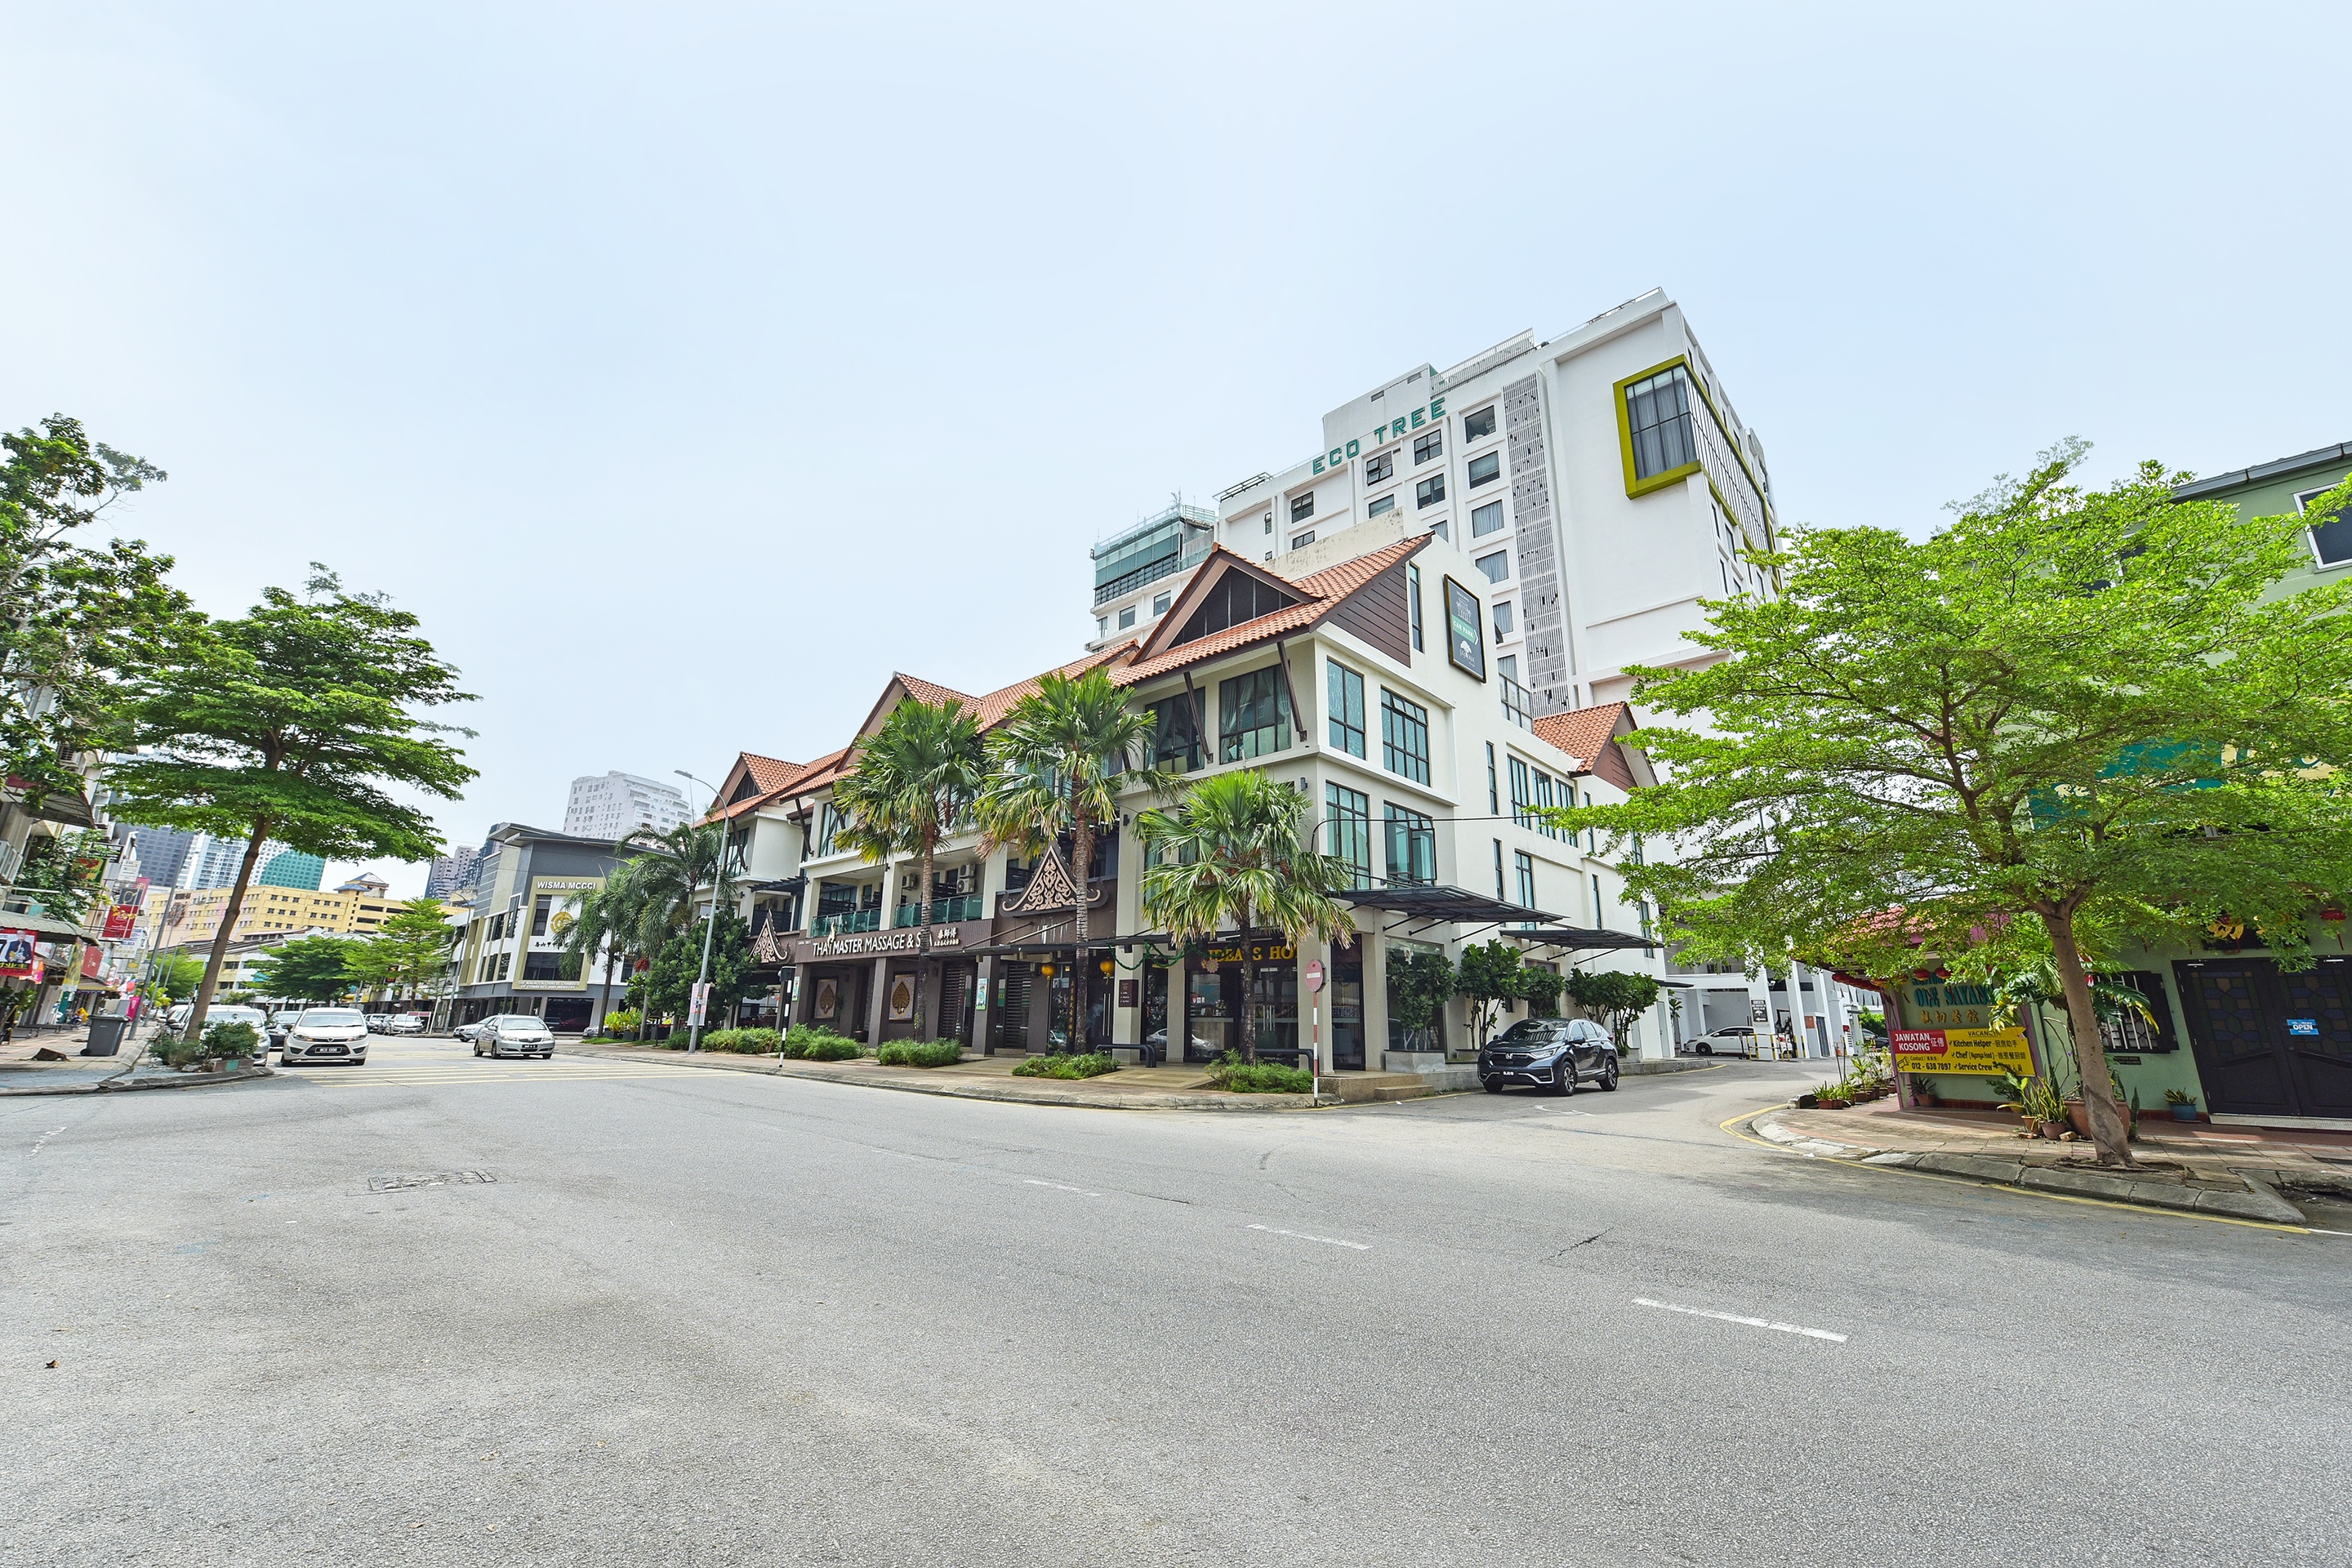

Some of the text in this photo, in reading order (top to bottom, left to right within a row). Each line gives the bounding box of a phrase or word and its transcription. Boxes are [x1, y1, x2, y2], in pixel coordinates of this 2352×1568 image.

[1312, 396, 1446, 475] ECO TREE
[1454, 621, 1474, 638] CAR PARK
[537, 881, 597, 890] WISMA MCCCI
[832, 938, 862, 955] MASTER
[864, 934, 905, 952] MASSAGE
[906, 935, 914, 948] &
[1269, 945, 1297, 960] HO
[1895, 1033, 1931, 1042] JAWATAN
[1899, 1043, 1931, 1051] KOSONG
[1953, 1040, 1972, 1048] Kitchen
[1973, 1040, 1992, 1049] Helper
[1956, 1051, 1967, 1060] Chef
